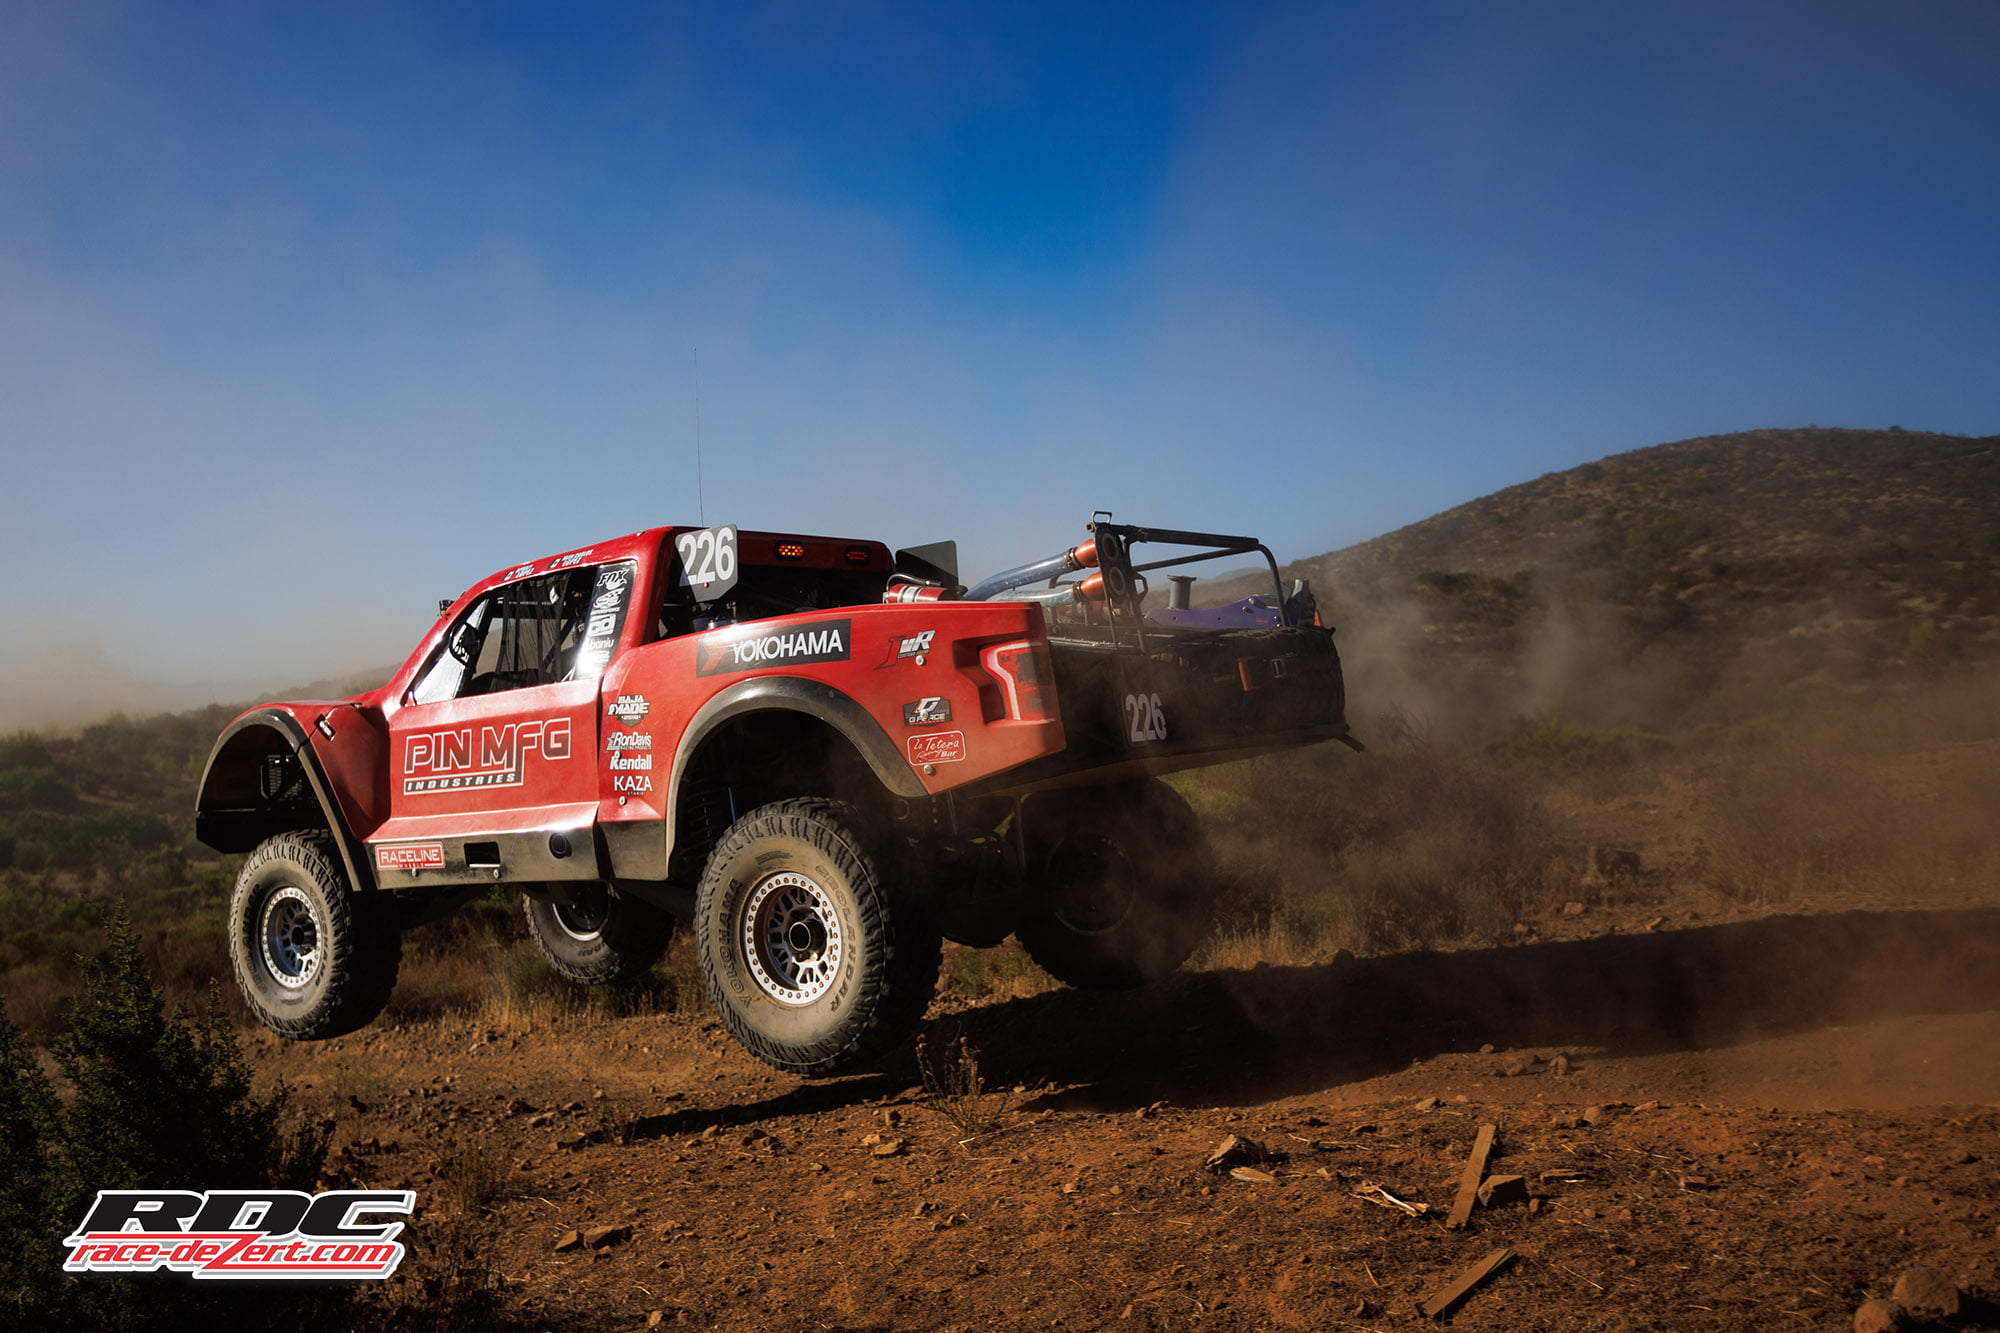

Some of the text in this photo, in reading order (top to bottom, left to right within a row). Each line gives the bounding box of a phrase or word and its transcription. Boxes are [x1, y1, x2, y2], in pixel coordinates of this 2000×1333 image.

[679, 527, 735, 587] 226
[596, 569, 630, 588] FOX
[732, 629, 844, 664] YOKOHAMA
[916, 713, 946, 722] FRCE
[1125, 692, 1167, 743] 226
[404, 717, 571, 775] PIN MFG
[609, 753, 653, 770] Kendall
[407, 773, 516, 791] INDUSTRIES
[614, 775, 653, 791] KAZA
[380, 848, 440, 863] RACELINE
